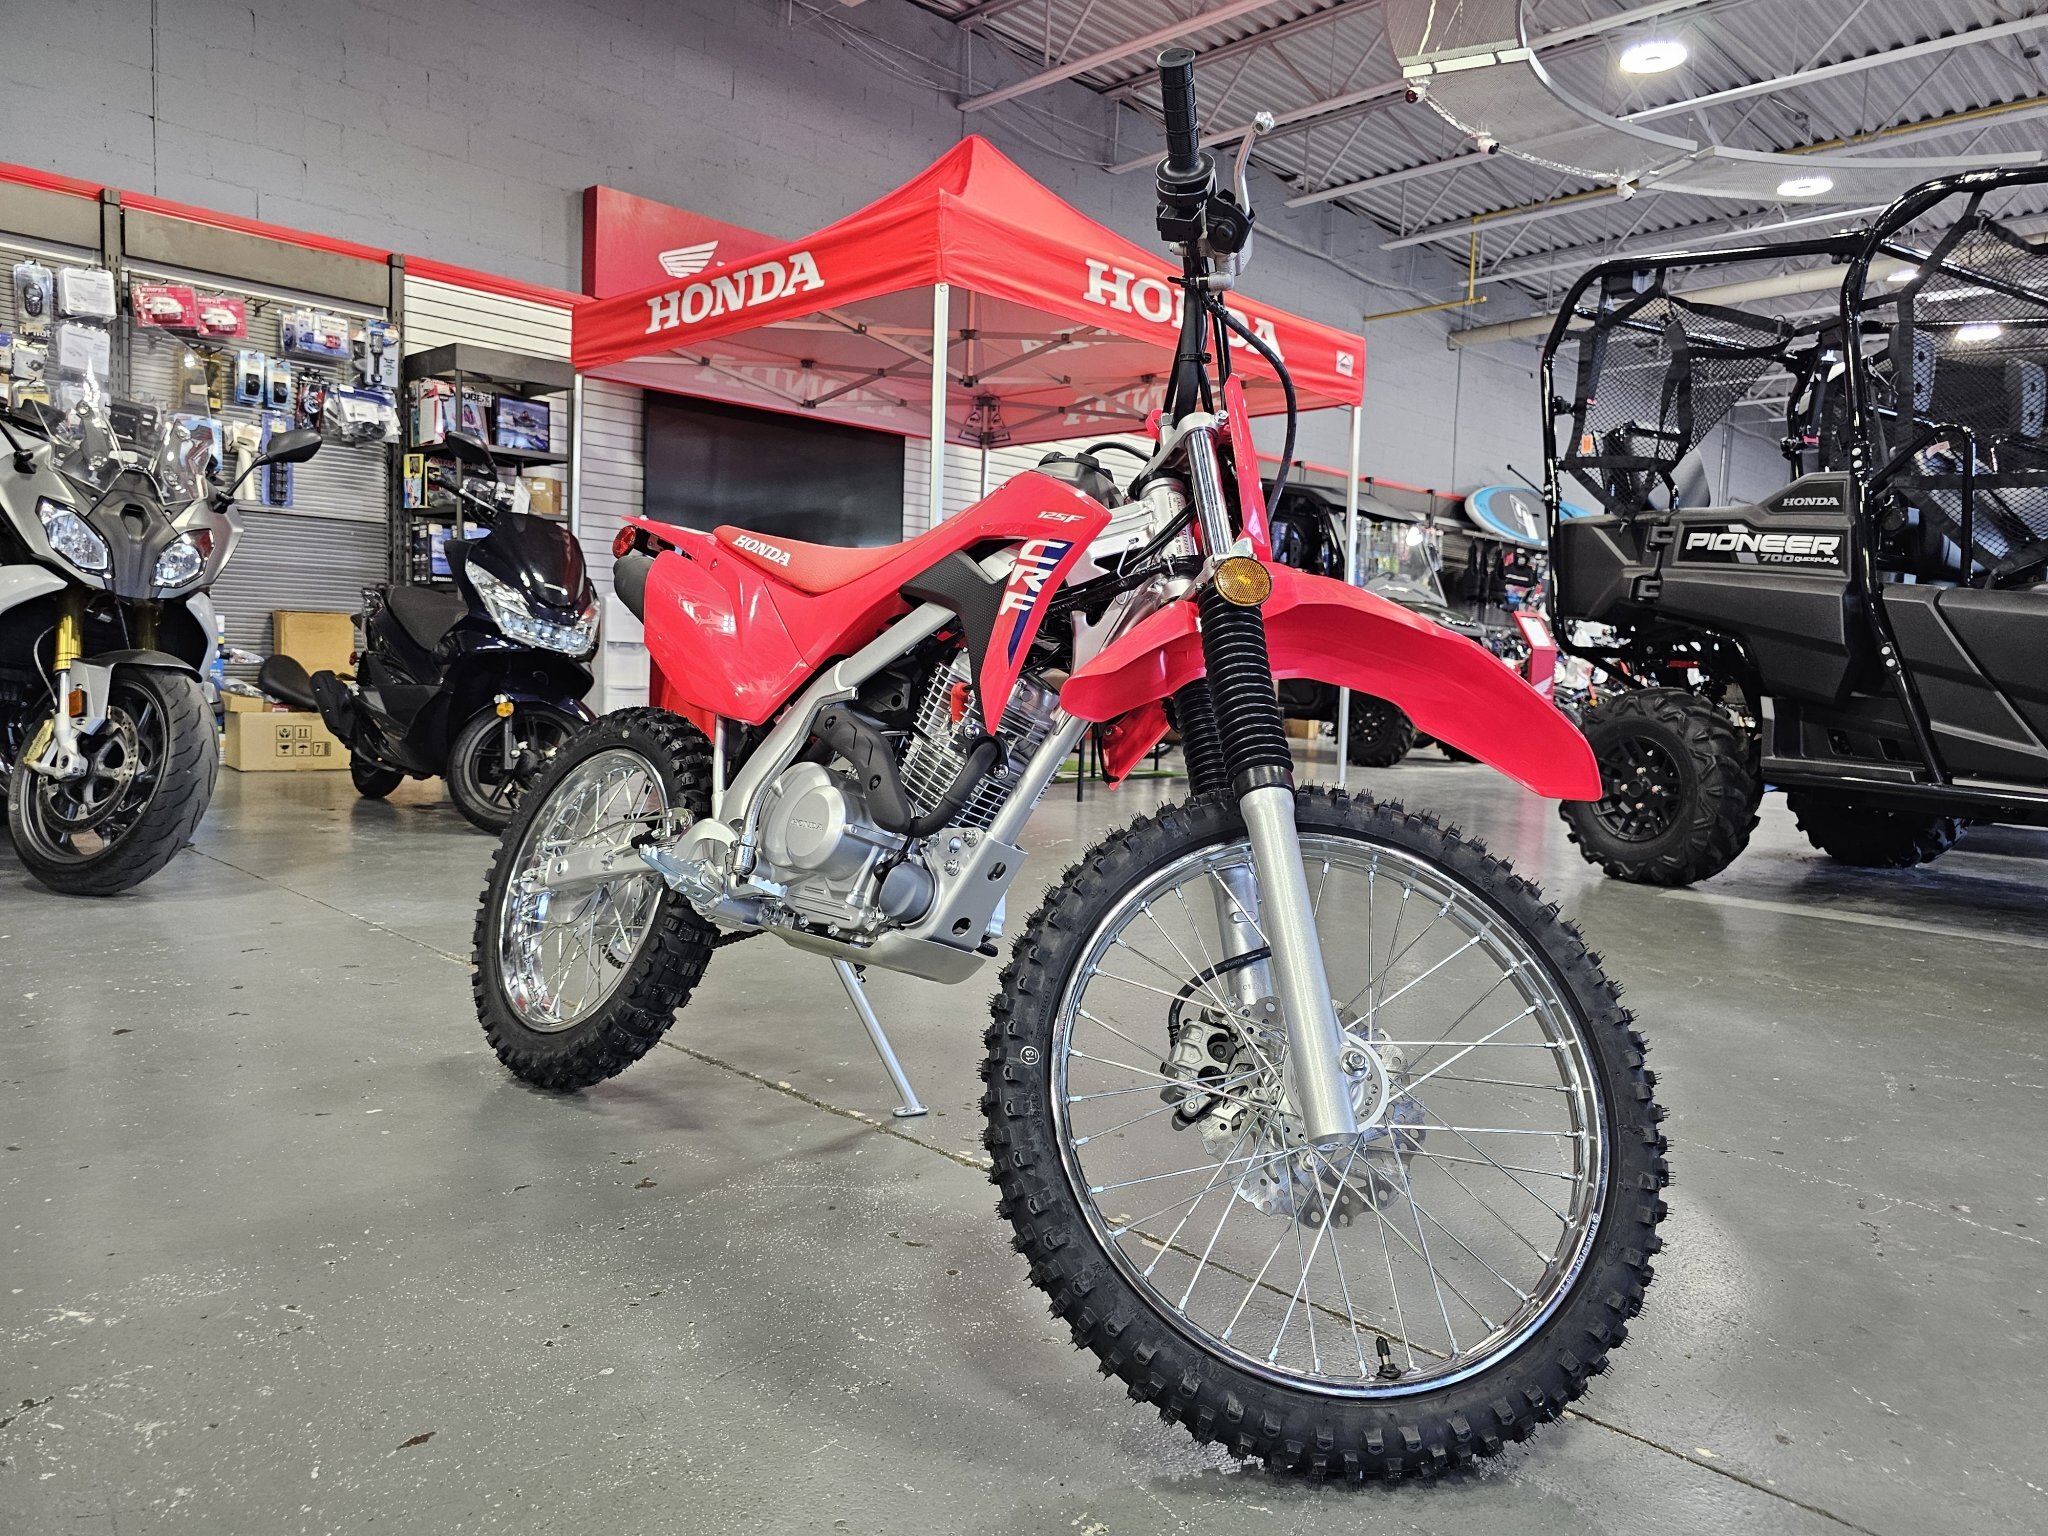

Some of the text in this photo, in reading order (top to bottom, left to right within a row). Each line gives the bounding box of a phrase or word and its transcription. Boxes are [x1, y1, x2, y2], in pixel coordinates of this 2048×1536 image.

[645, 251, 825, 334] HONDA
[1782, 497, 1840, 507] HONDA
[1037, 511, 1087, 523] 125F
[732, 535, 791, 567] HONDA
[1686, 532, 1841, 555] PIONEER
[1760, 553, 1794, 562] 700
[1000, 540, 1067, 616] CRF
